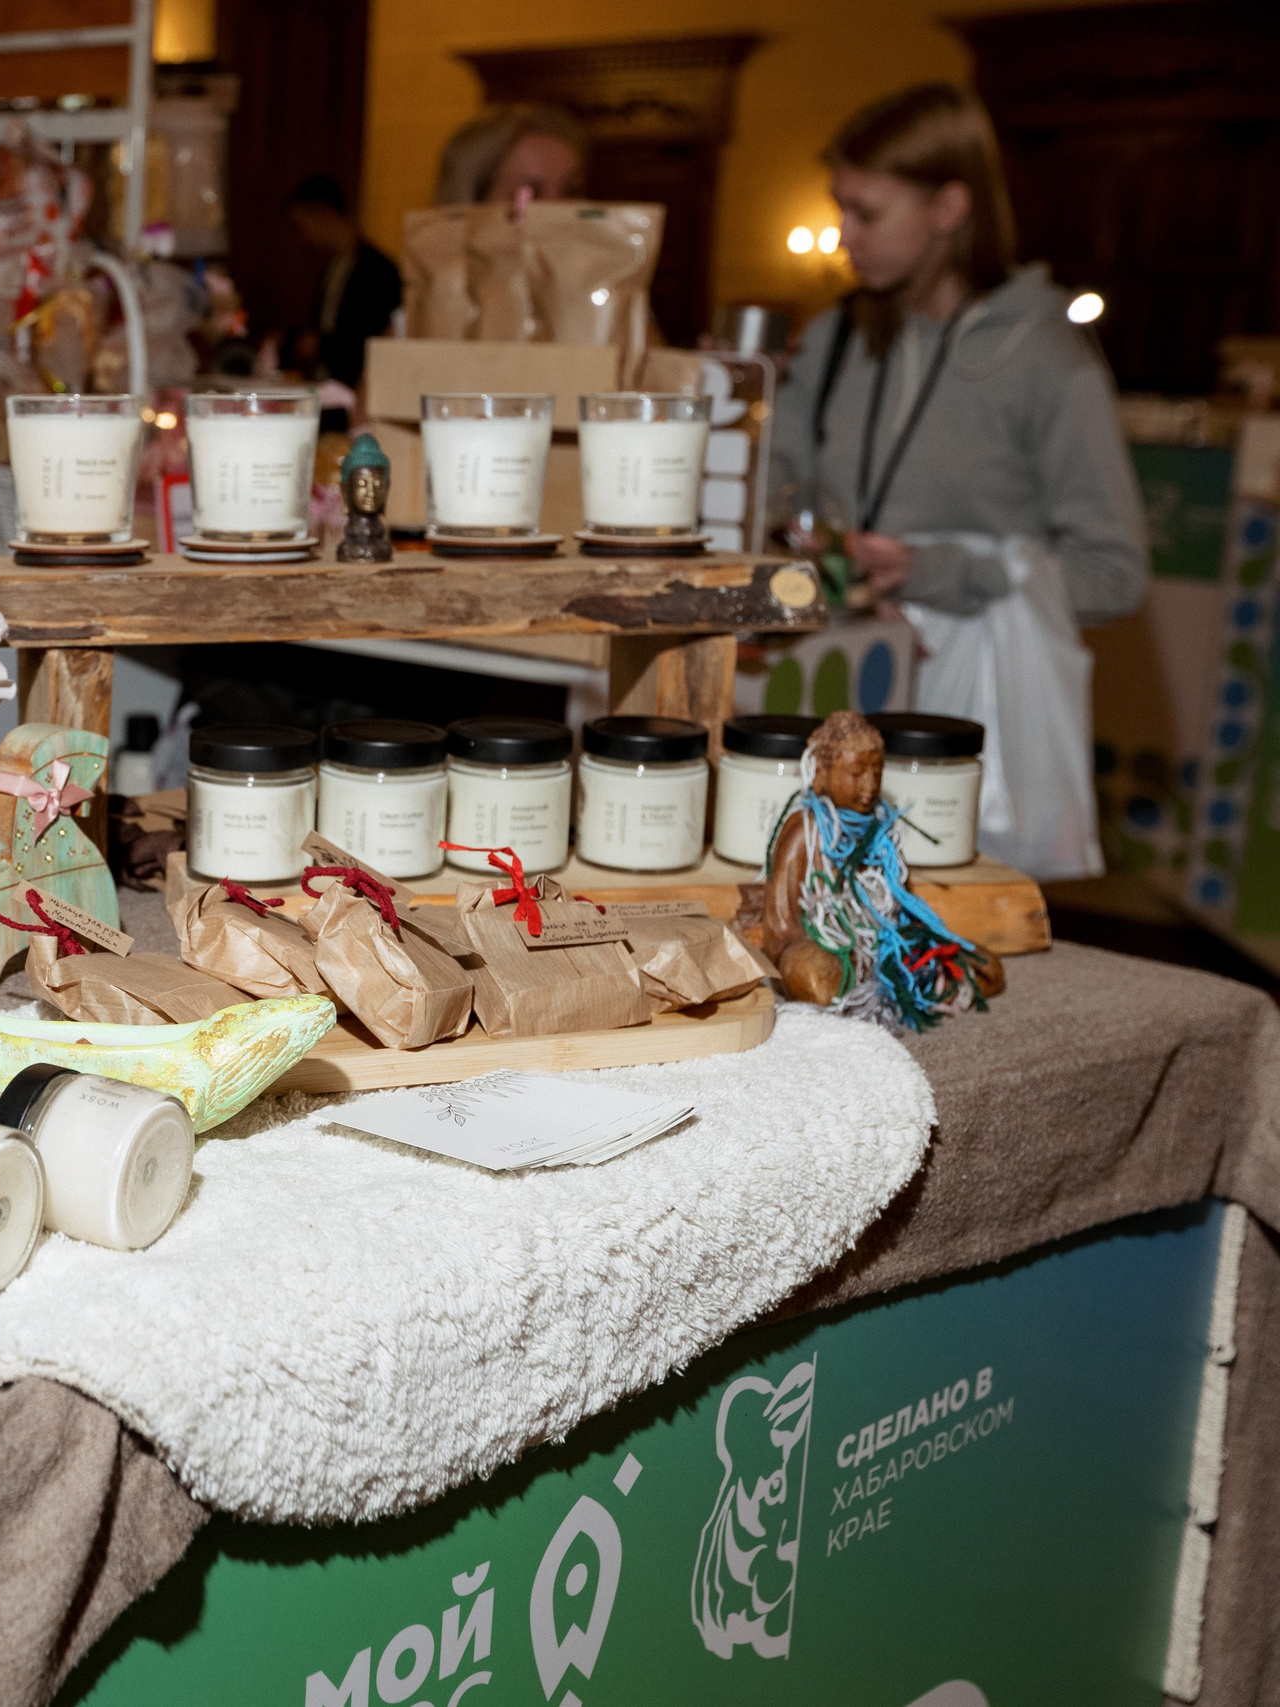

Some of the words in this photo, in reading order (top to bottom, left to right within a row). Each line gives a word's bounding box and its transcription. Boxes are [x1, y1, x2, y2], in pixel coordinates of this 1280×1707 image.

[80, 1092, 119, 1110] WOSK
[493, 1137, 545, 1153] WOSK
[830, 1396, 1015, 1516] ХАБАРОВСКОМ
[836, 1378, 970, 1469] СДЕЛАНО
[974, 1365, 994, 1401] В
[826, 1498, 893, 1557] КРАЕ
[305, 1560, 495, 1707] МОЙ
